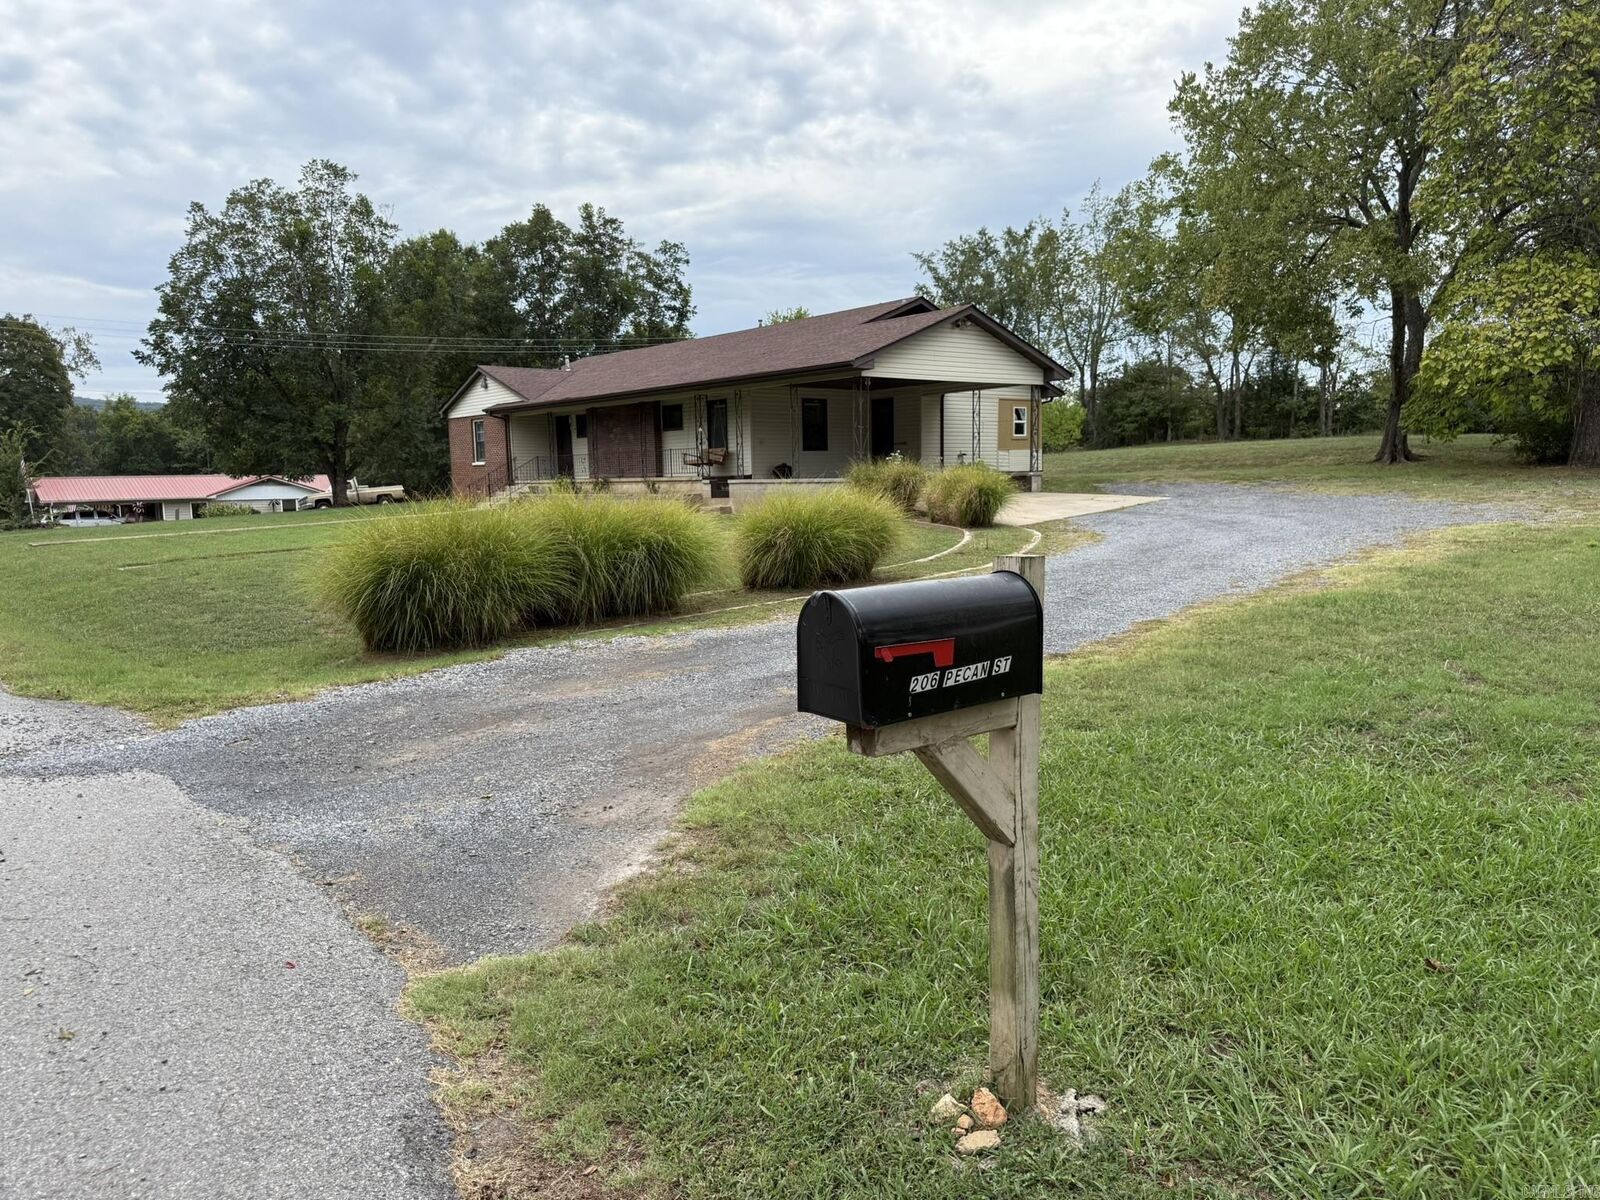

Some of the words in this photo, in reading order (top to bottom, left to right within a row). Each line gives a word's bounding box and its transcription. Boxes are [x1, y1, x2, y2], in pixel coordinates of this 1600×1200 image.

[911, 672, 939, 693] 206
[944, 662, 990, 687] PECAN
[993, 657, 1011, 675] ST
